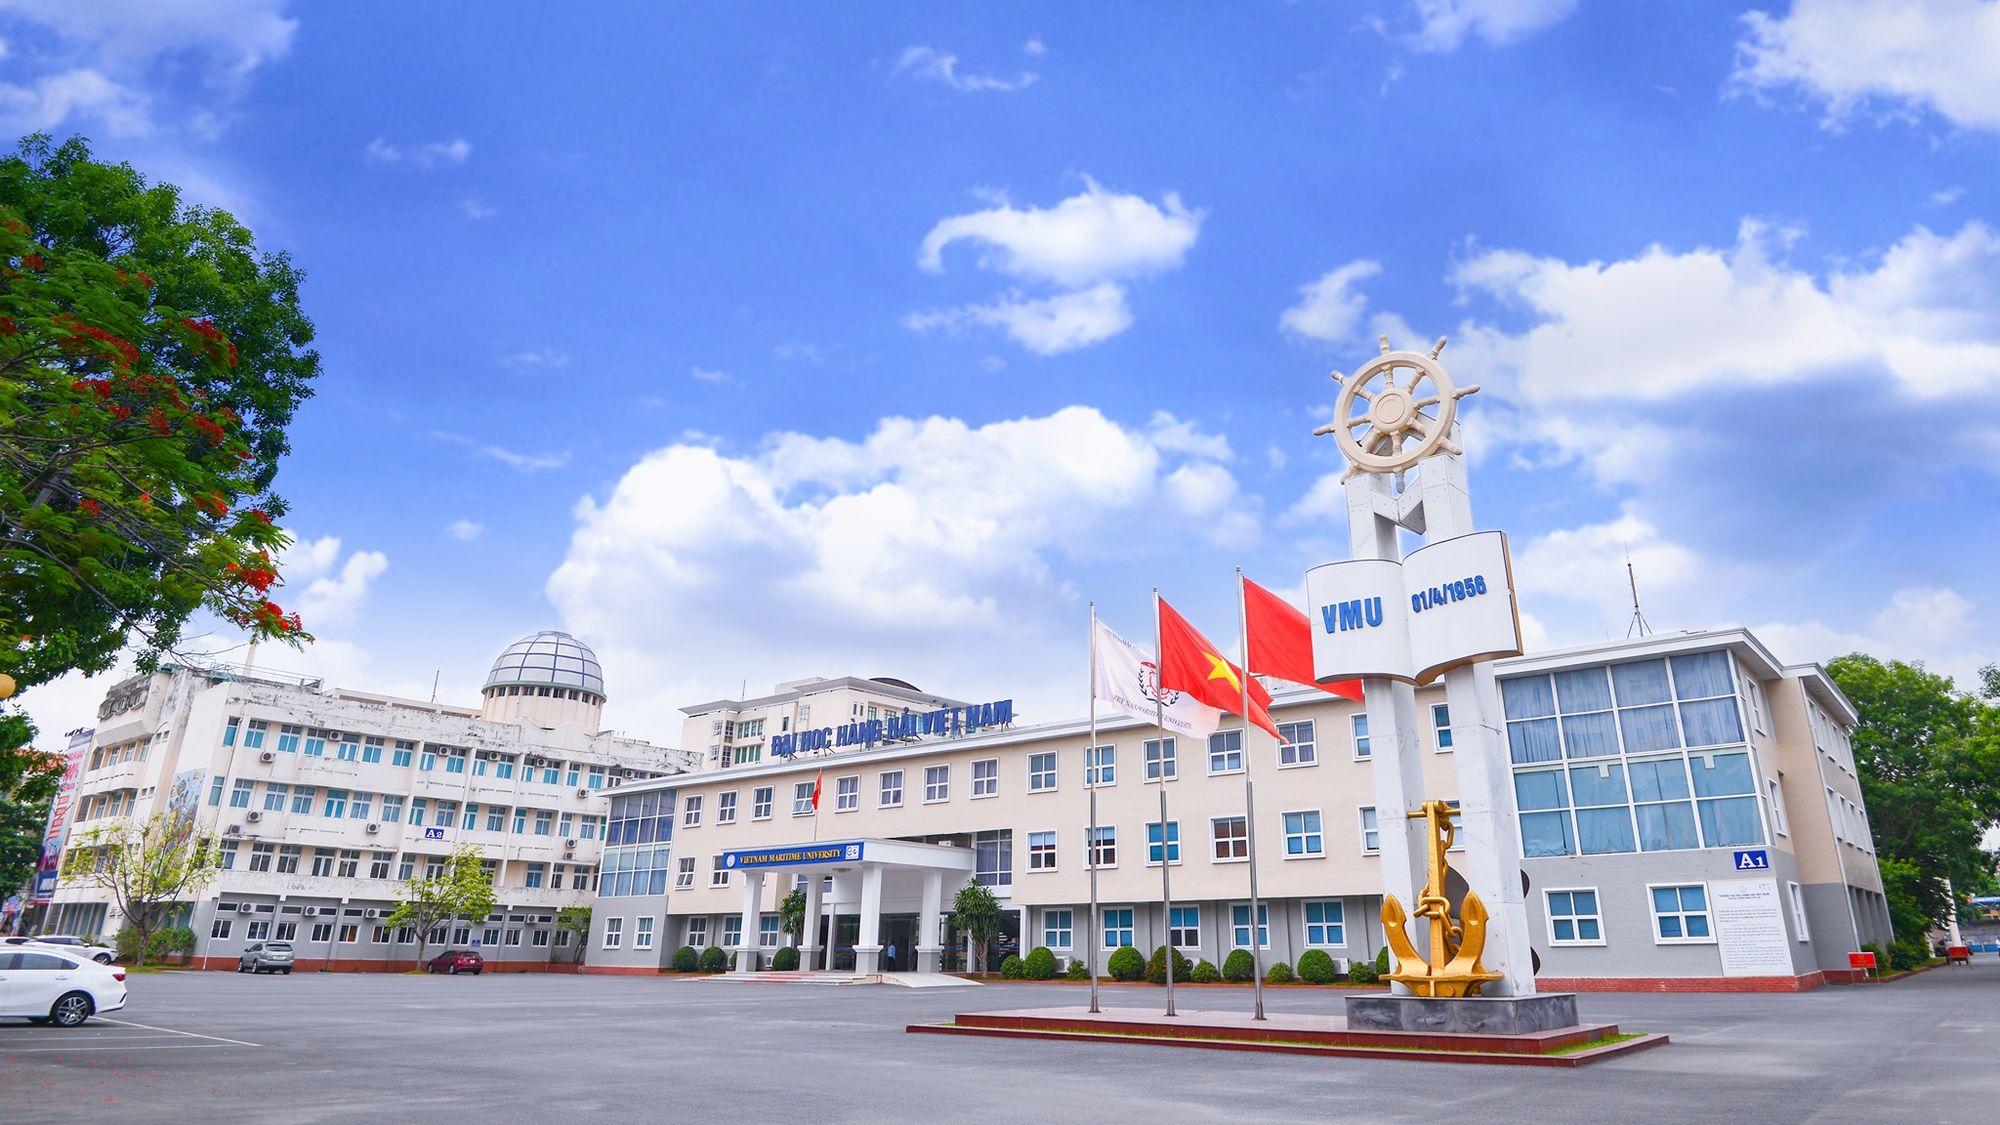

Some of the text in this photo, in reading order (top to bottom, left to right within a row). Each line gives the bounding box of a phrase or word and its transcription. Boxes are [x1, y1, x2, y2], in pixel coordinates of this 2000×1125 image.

[1411, 575, 1487, 613] 01/4/1956
[1321, 597, 1383, 634] VMU
[836, 718, 883, 747] HÀNG
[887, 707, 917, 739] HẢI
[965, 699, 1013, 730] NAM
[426, 829, 443, 838] A2
[739, 855, 769, 865] VIETNAM
[769, 852, 801, 863] MARITIME
[802, 849, 842, 860] UNIVERSITY
[1739, 853, 1766, 868] A1
